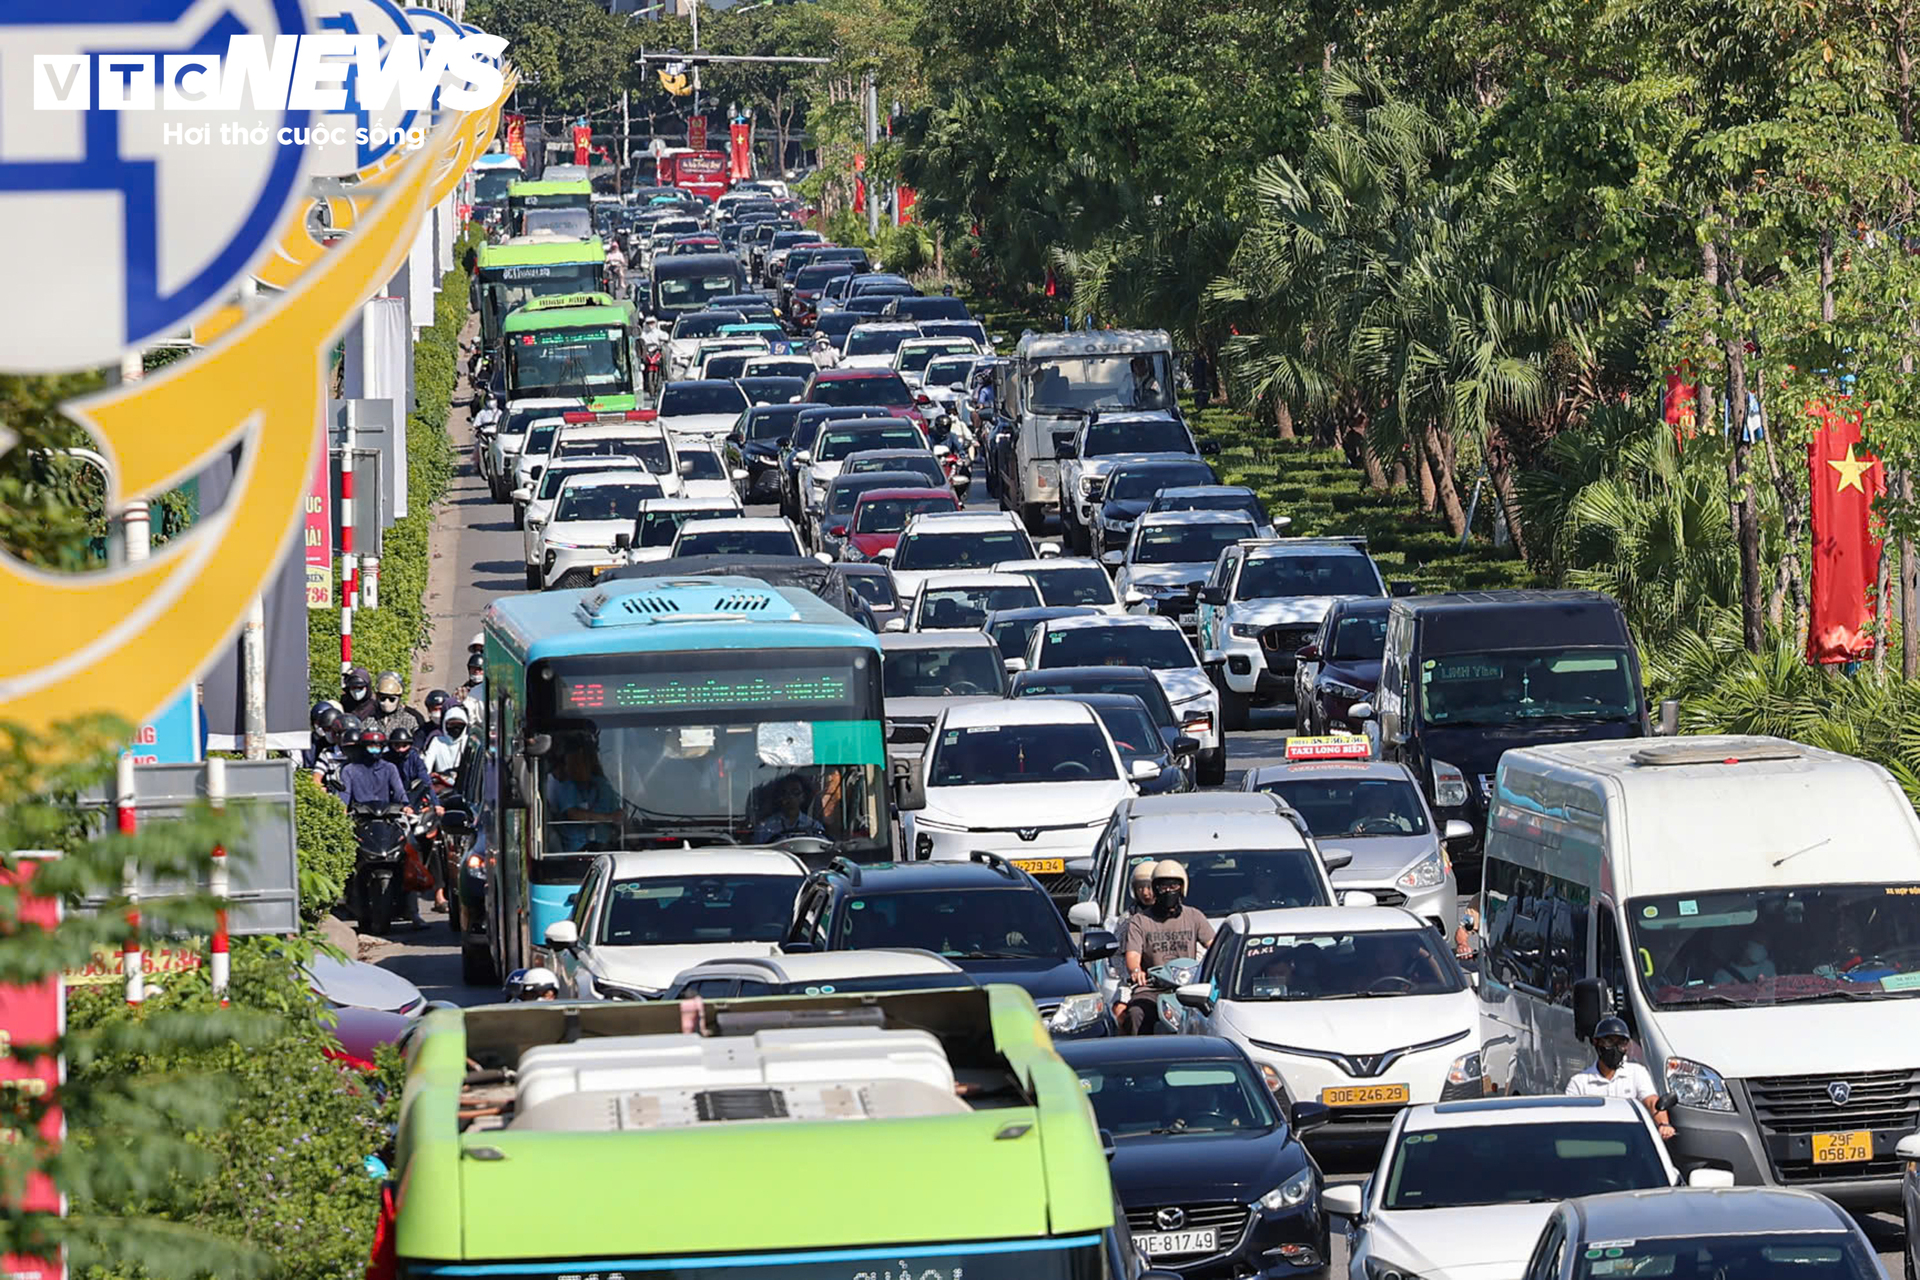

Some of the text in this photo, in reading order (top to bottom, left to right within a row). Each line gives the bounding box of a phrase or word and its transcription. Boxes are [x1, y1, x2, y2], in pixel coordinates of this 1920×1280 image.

[1290, 747, 1314, 756] TAXI
[1315, 746, 1341, 755] LONG
[1330, 1087, 1403, 1103] 30E-246.29
[1828, 1132, 1855, 1147] 29F
[1819, 1146, 1867, 1161] 058.78
